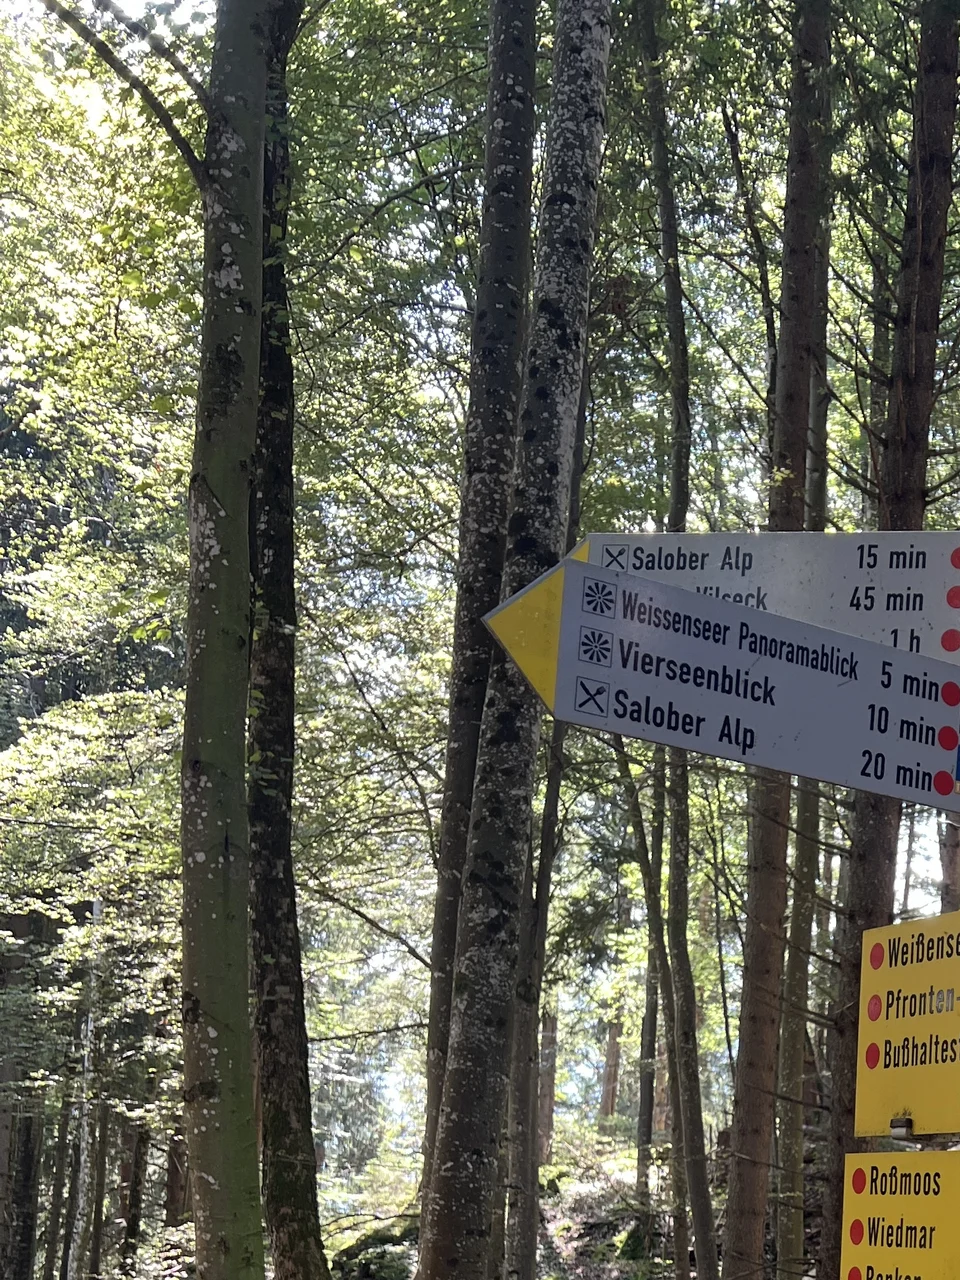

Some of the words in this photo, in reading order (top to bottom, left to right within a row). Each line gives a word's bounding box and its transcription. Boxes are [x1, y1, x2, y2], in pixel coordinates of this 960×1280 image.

[632, 547, 709, 571] Salober
[721, 548, 753, 576] Alp
[857, 545, 878, 569] 15
[889, 545, 926, 569] min
[849, 588, 875, 611] 45
[886, 587, 924, 611] min
[621, 591, 730, 645] Weissenseer
[739, 622, 859, 681] Panoramablick
[881, 662, 892, 689] 5
[902, 667, 940, 702] min
[891, 629, 898, 648] 1
[909, 629, 920, 653] h
[618, 639, 776, 706] Vierseenblick
[868, 704, 889, 734] 10
[900, 710, 936, 747] min
[613, 691, 706, 738] Salober
[718, 716, 755, 754] Alp
[861, 750, 885, 779] 20
[896, 755, 933, 793] min
[869, 1165, 941, 1196] Roßmoos
[867, 1216, 936, 1250] Wiedmar
